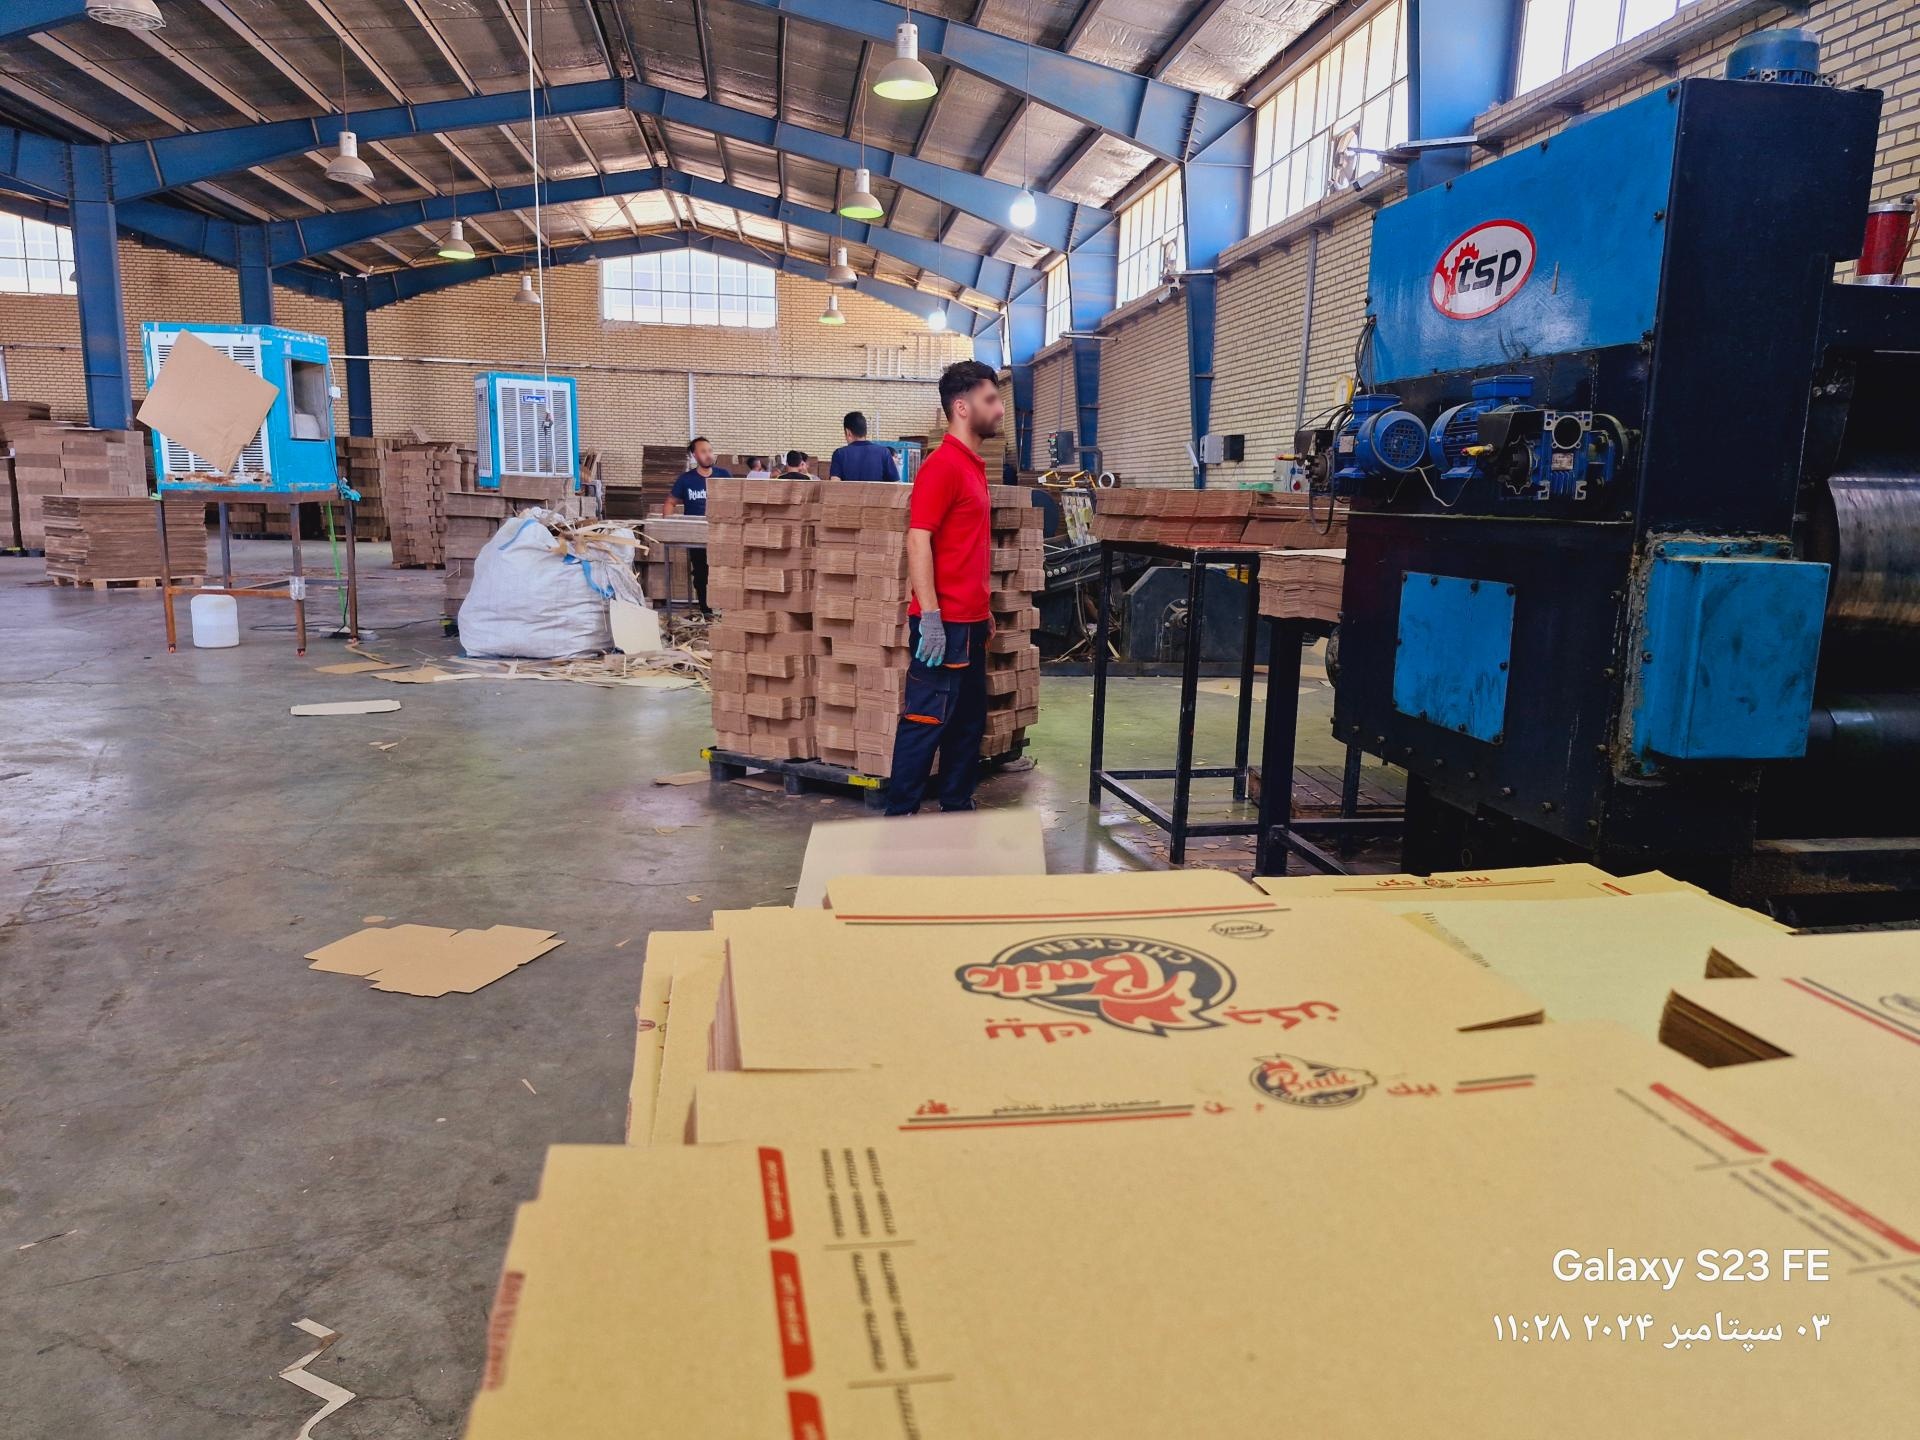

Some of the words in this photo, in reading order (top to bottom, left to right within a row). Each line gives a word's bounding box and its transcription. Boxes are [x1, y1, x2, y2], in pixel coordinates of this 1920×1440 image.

[1457, 248, 1522, 297] tsp
[964, 951, 1150, 998] Baik
[1031, 936, 1194, 966] CHICKEN
